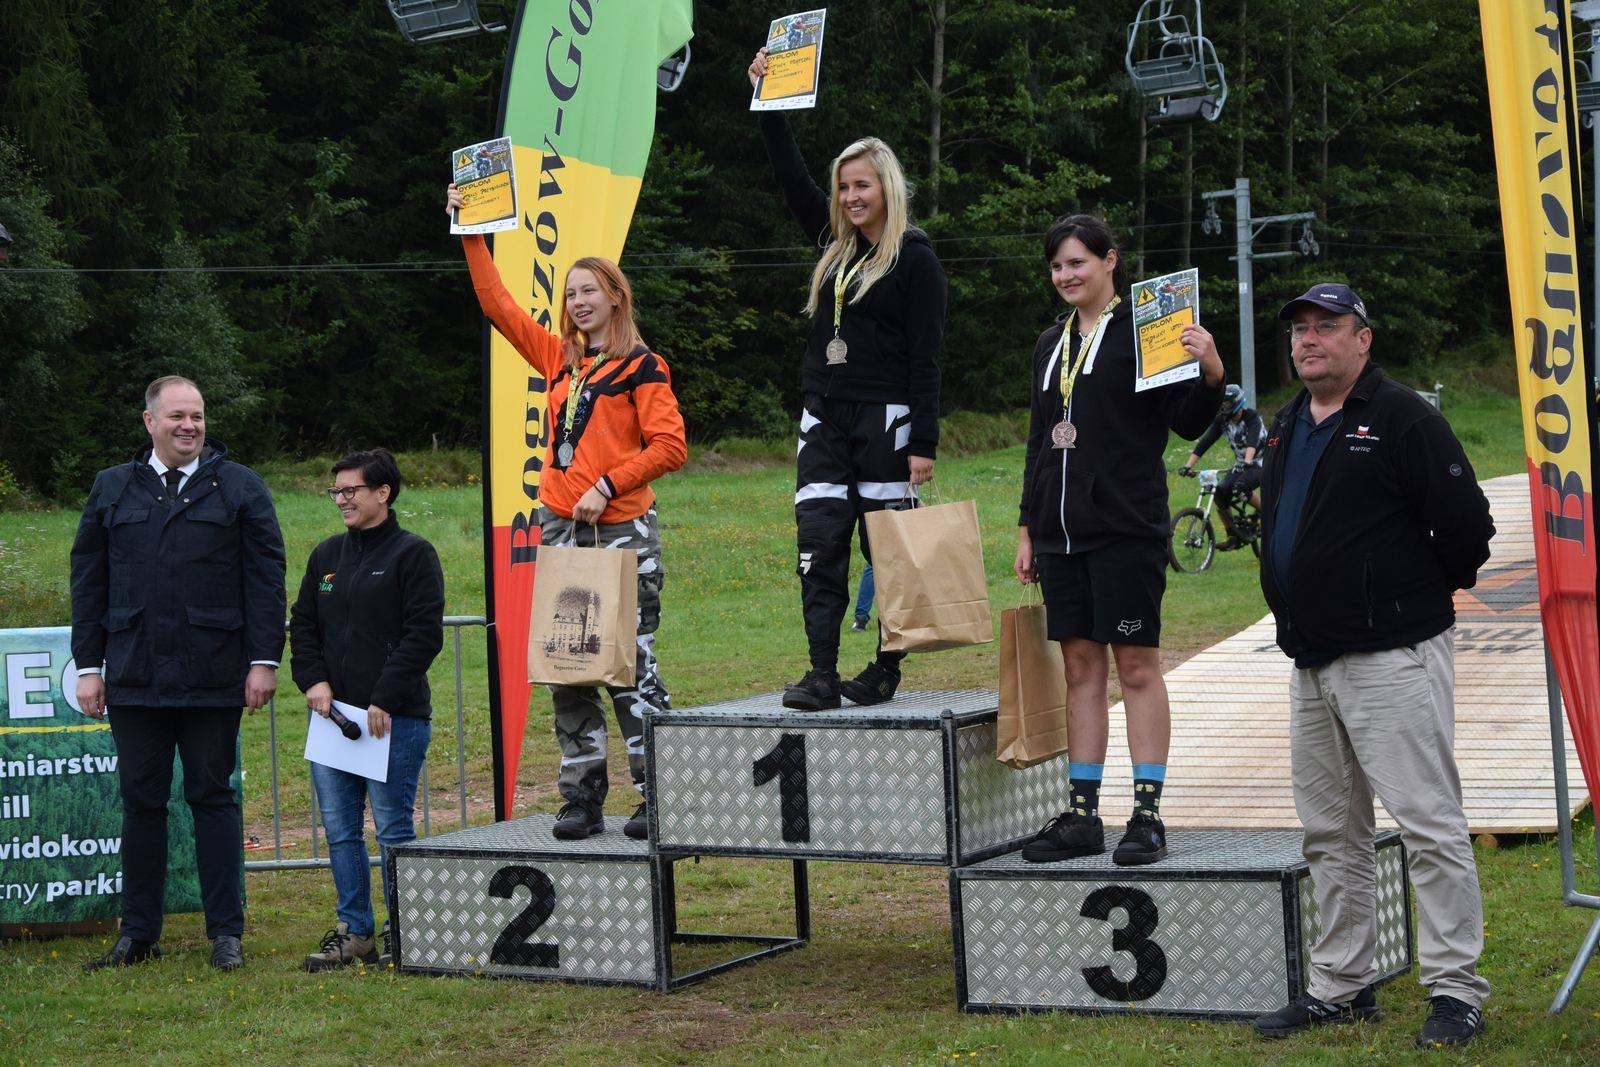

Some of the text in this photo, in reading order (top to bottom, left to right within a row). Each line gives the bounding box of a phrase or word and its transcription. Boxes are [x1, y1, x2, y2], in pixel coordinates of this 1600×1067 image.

[766, 50, 798, 63] DYPLOM
[458, 179, 491, 193] DYPLOM
[1140, 316, 1173, 334] DYPLOM
[753, 732, 811, 843] 1
[0, 795, 30, 818] ill
[488, 865, 560, 969] 2
[1080, 885, 1168, 1001] 3
